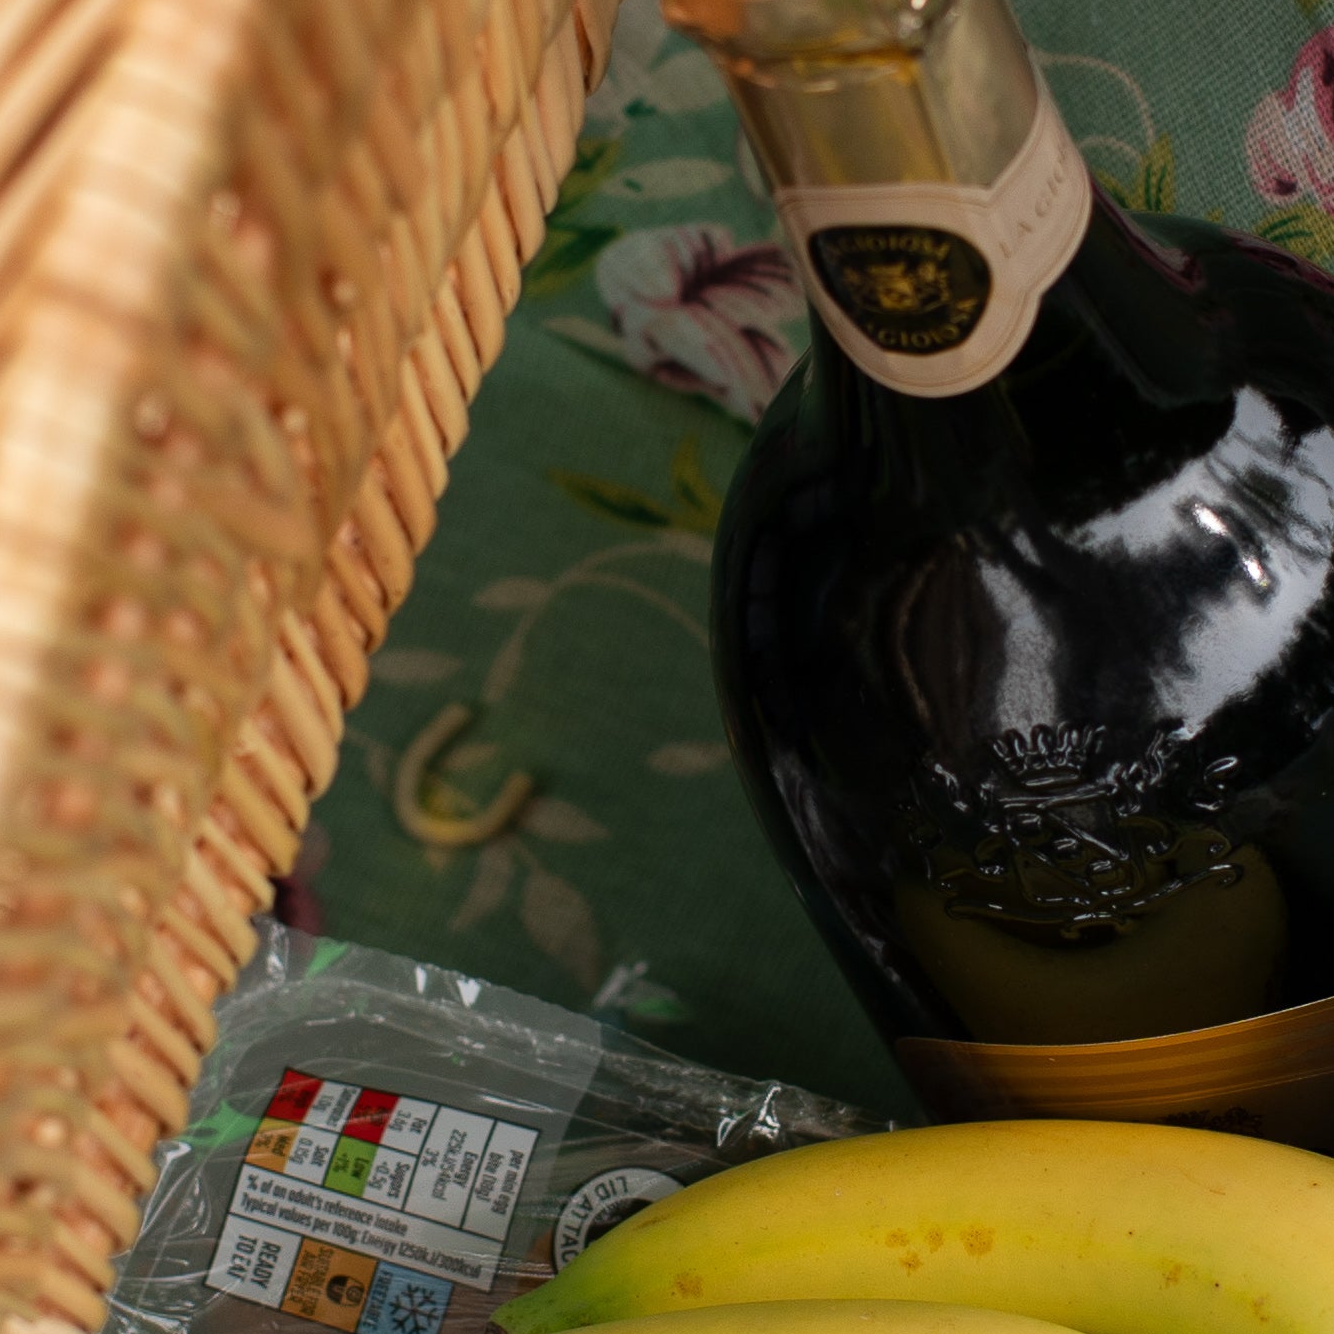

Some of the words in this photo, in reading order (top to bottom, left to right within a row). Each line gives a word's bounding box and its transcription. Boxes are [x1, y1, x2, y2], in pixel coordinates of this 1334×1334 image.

[409, 1115, 428, 1136] Fat
[309, 1143, 330, 1168] Salt
[349, 1155, 369, 1181] Low
[451, 1146, 480, 1189] Energy
[504, 1148, 525, 1173] per
[383, 1159, 411, 1200] Sugars
[594, 1175, 629, 1201] LID
[259, 1176, 275, 1194] of
[322, 1198, 374, 1226] reference
[490, 1192, 511, 1216] egg
[241, 1193, 279, 1220] Typical
[277, 1203, 314, 1227] values
[311, 1216, 332, 1236] per
[358, 1229, 398, 1257] Energy
[560, 1193, 594, 1263] ATTAC
[233, 1234, 257, 1255] TO
[224, 1252, 250, 1283] EAT
[251, 1240, 282, 1290] READY
[304, 1244, 335, 1297] SUITABLE
[296, 1292, 319, 1318] FOR
[360, 1268, 394, 1331] FREEZABLE
